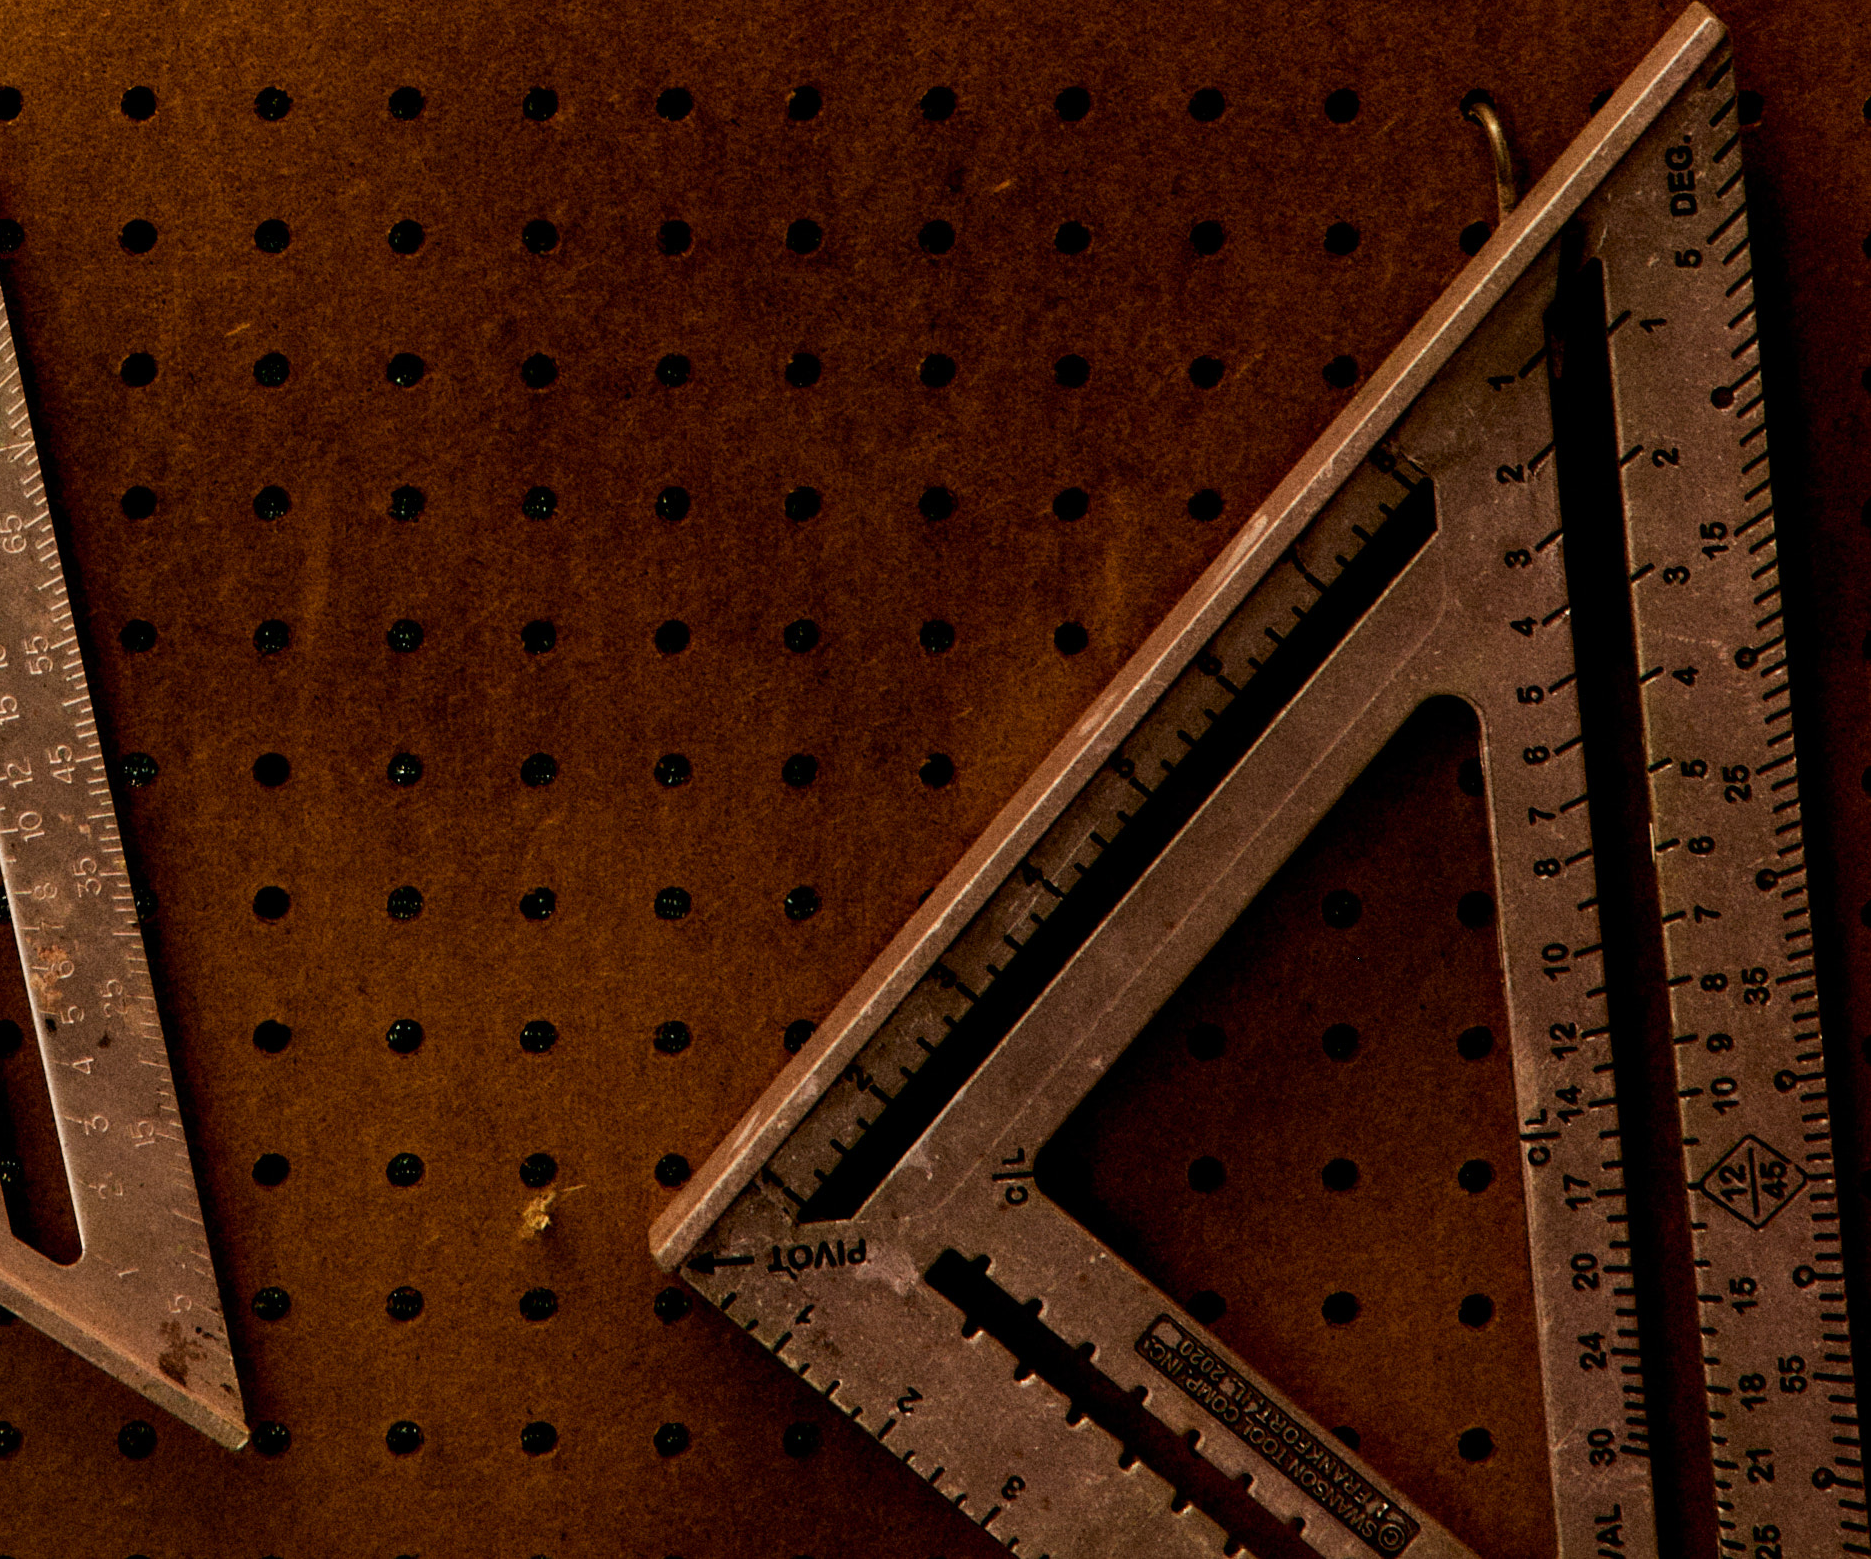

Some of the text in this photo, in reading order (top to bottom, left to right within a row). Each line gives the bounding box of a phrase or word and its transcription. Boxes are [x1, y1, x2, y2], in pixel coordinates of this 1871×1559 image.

[1487, 375, 1516, 391] 1
[1496, 464, 1525, 485] 2
[0, 515, 27, 554] 65
[1504, 548, 1533, 569] 3
[1510, 616, 1538, 638] 4
[23, 635, 53, 675] 55
[1516, 684, 1545, 705] 5
[6, 759, 34, 789] 12
[48, 745, 76, 784] 45
[1523, 745, 1551, 766] 6
[1665, 134, 1807, 1394] 55 35 25 15 5 DEG.
[18, 811, 45, 841] 10
[1528, 807, 1556, 825] 7
[72, 858, 102, 898] 35
[1533, 857, 1561, 879] 8
[32, 882, 58, 901] 8
[1638, 317, 1782, 1559] 25 21 18 15 10 9 8 7 6 5 4 3 2 1
[1541, 943, 1570, 982] 10
[60, 1005, 84, 1024] 5
[1549, 1022, 1579, 1061] 12
[72, 1057, 94, 1075] 4
[1555, 1084, 1585, 1126] 14
[84, 1115, 110, 1135] 3
[130, 1120, 155, 1147] 15
[1563, 1174, 1592, 1212] 17
[1718, 1164, 1748, 1204] 12
[1759, 1160, 1789, 1201] 45
[767, 1239, 868, 1274] PIVOT
[1570, 1252, 1600, 1292] 20
[1178, 1341, 1227, 1381] 2020
[1577, 1331, 1608, 1372] 24
[795, 1304, 1027, 1501] 1 2 3
[1185, 1368, 1240, 1423] COMP.
[1243, 1418, 1290, 1465] TOOL
[1587, 1428, 1617, 1467] 30
[1288, 1460, 1378, 1539] SWANSON
